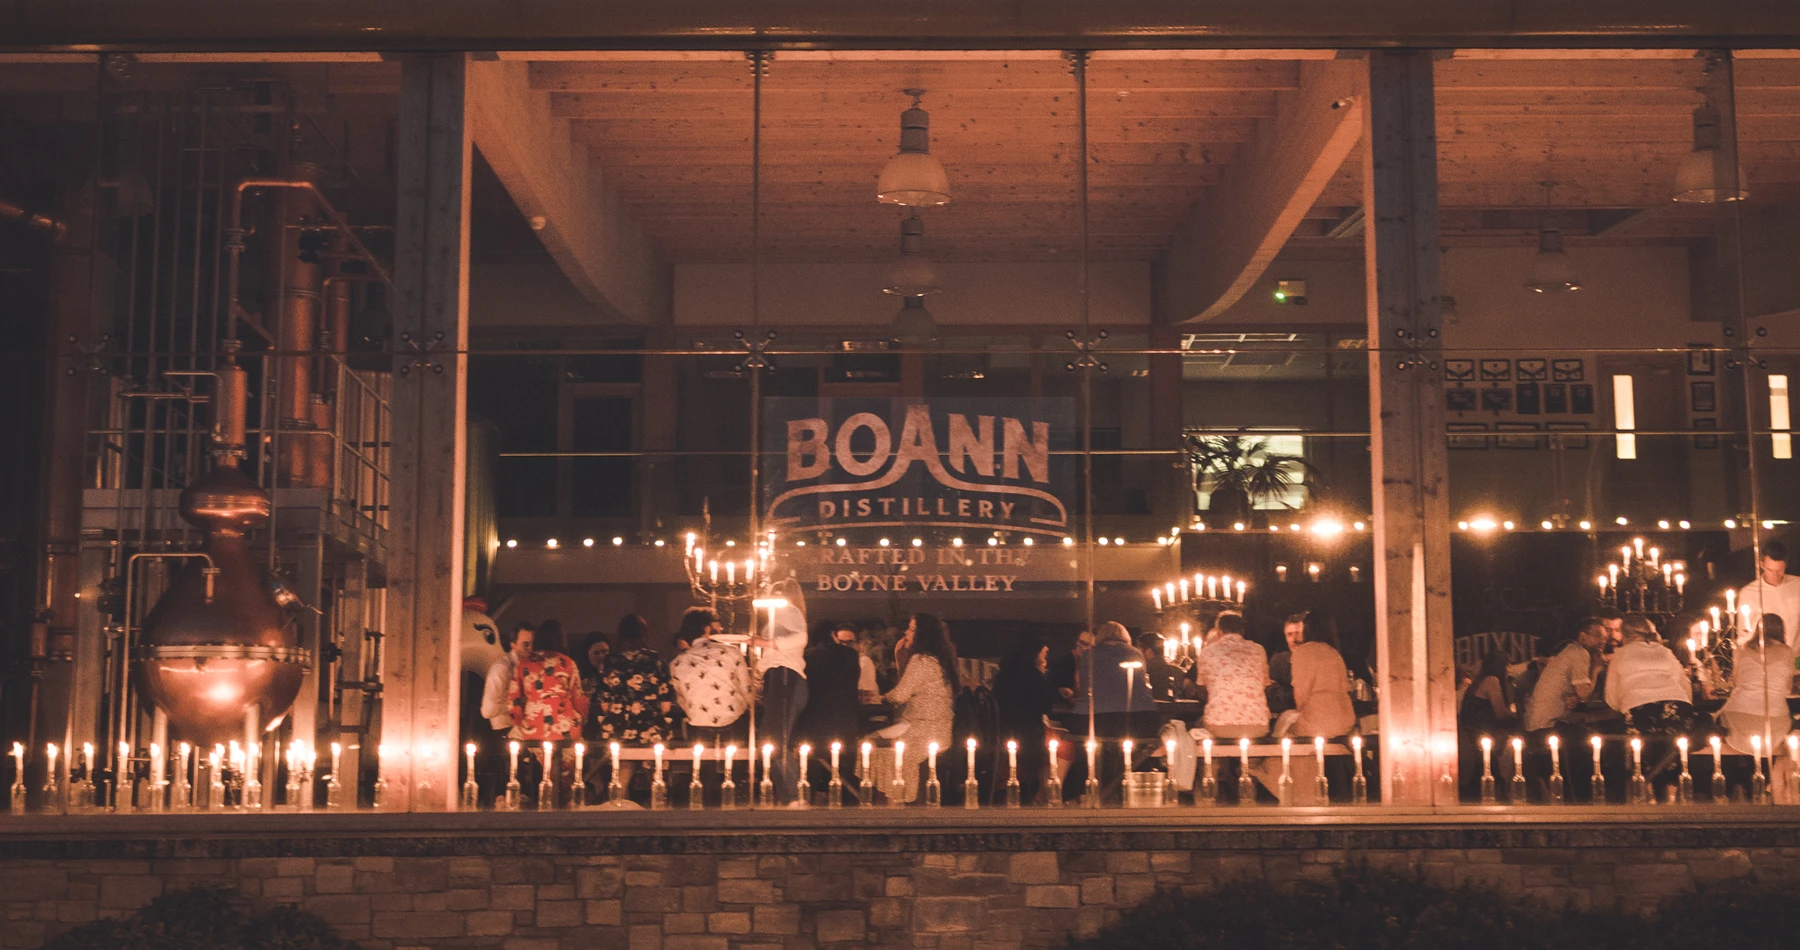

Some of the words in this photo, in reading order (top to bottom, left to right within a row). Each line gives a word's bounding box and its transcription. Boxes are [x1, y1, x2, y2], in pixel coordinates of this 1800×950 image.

[786, 404, 1050, 485] BOANN
[820, 498, 1016, 519] DISTILLERY
[807, 547, 925, 565] RAFTED
[936, 547, 968, 565] IN
[816, 574, 907, 591] BOYNE
[916, 574, 1019, 591] VALLEY
